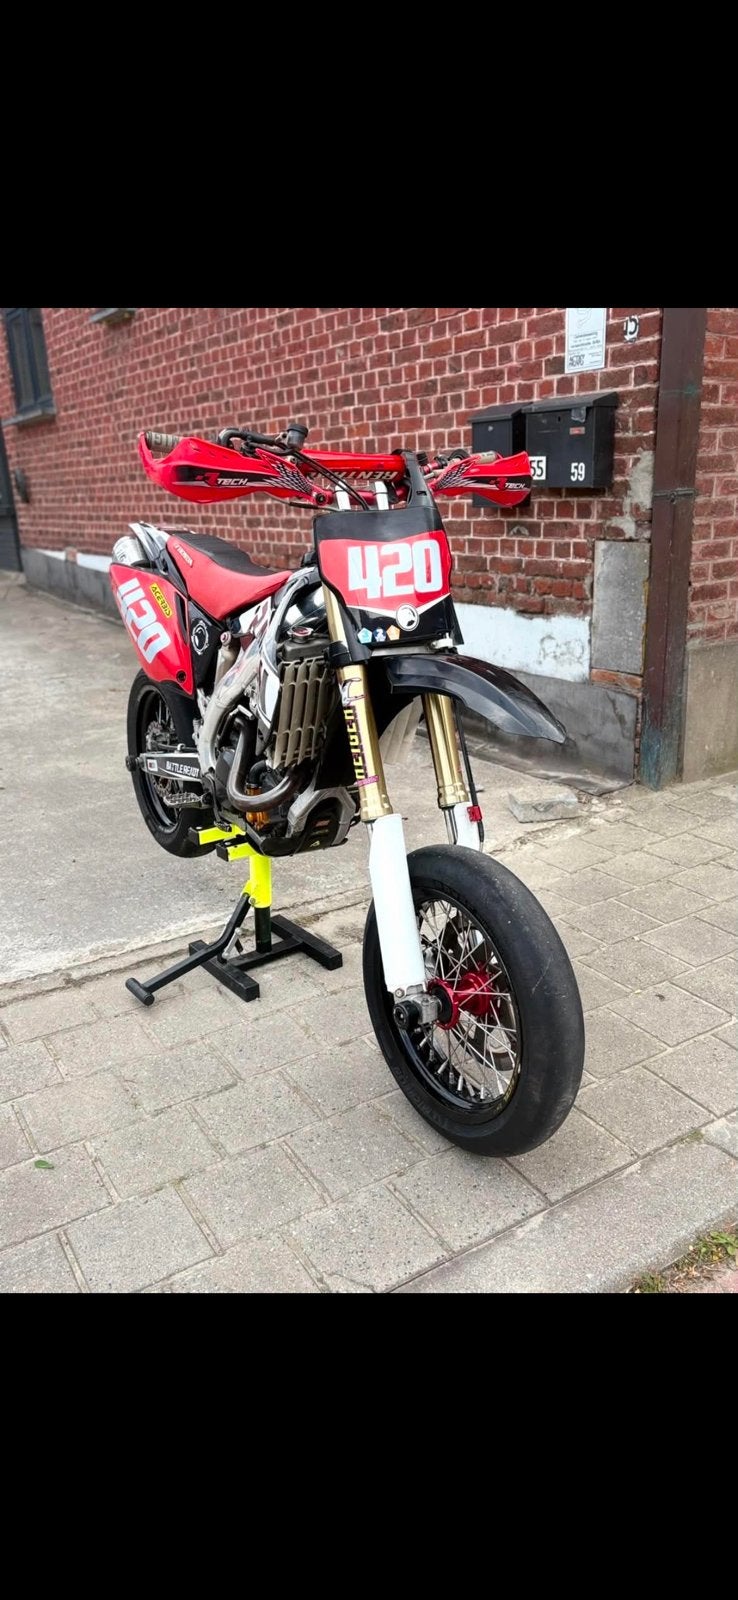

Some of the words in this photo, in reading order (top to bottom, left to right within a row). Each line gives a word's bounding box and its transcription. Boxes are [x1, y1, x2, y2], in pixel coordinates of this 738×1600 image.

[530, 460, 543, 477] 55
[570, 462, 585, 482] 59
[347, 539, 443, 599] 420
[151, 585, 172, 617] ACERBIS
